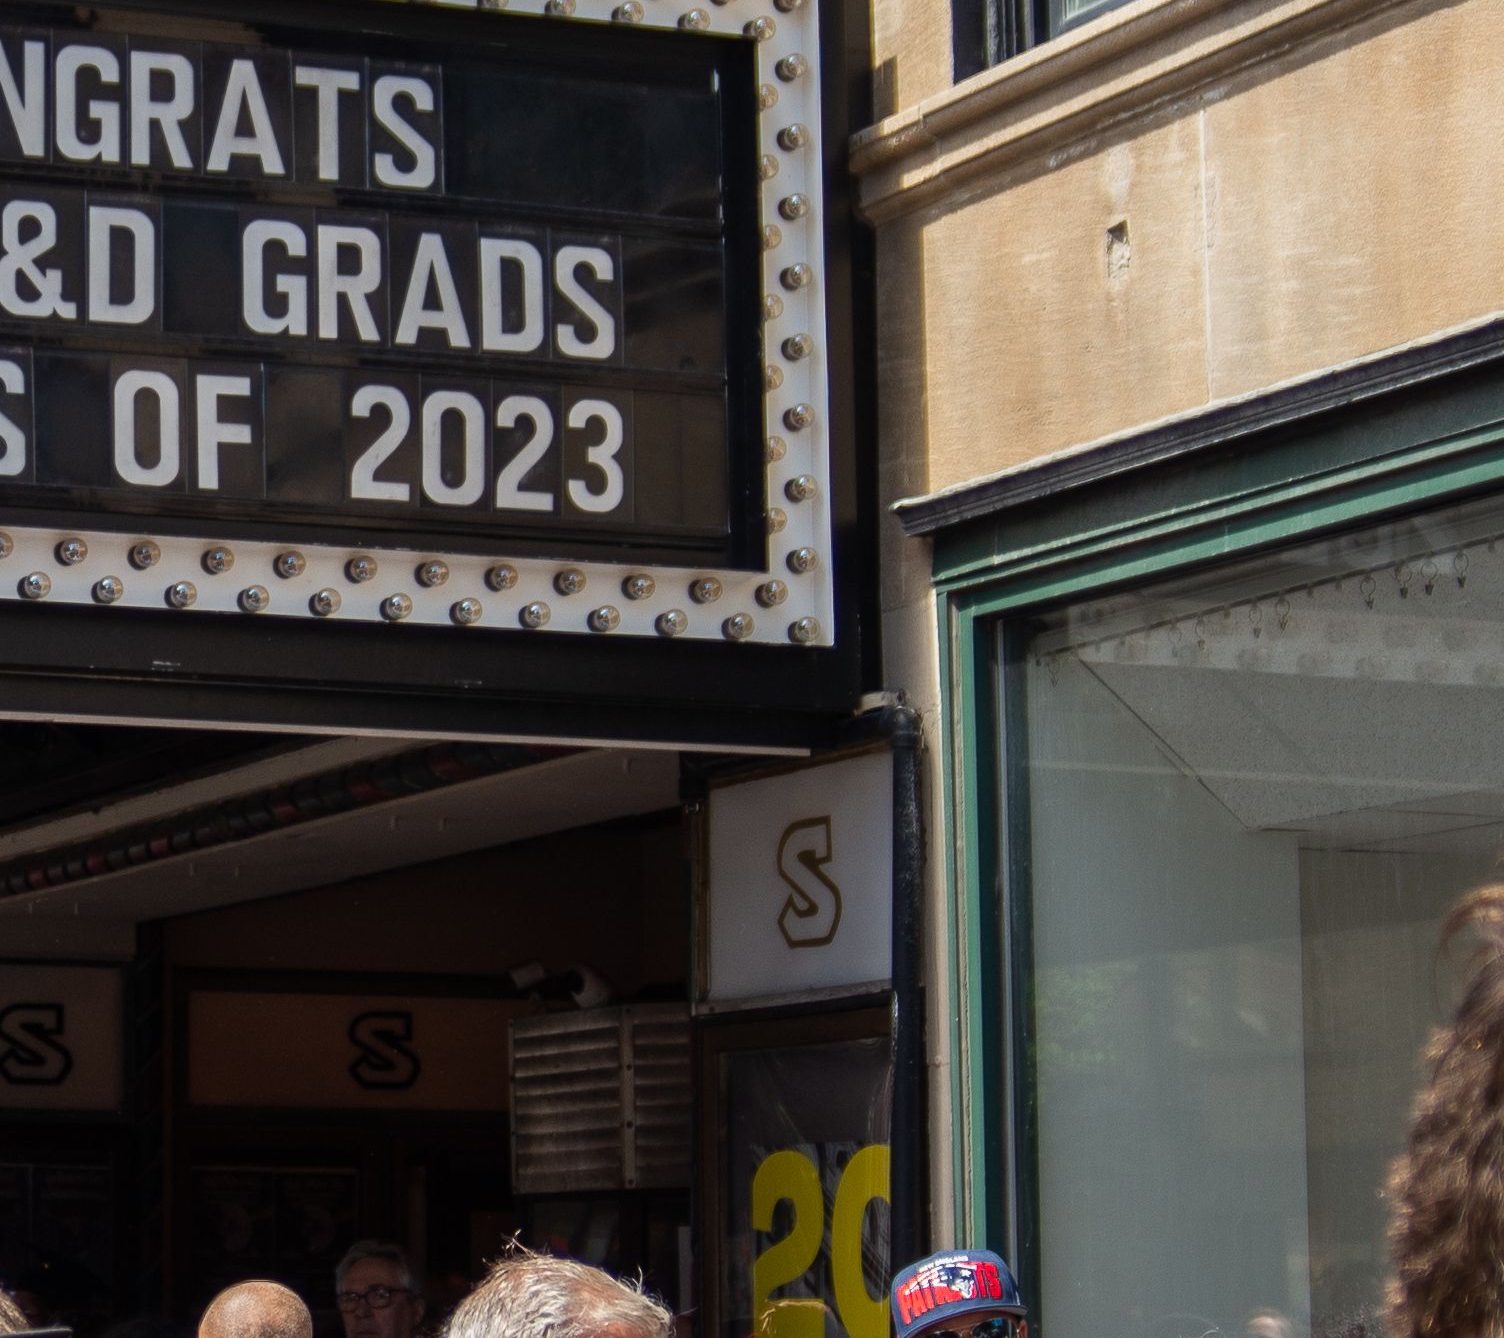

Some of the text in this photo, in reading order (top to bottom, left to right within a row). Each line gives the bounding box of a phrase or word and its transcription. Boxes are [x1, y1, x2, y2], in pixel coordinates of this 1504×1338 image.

[241, 218, 617, 361] GRADS
[112, 369, 253, 491] OF
[349, 384, 625, 513] 2023
[776, 815, 843, 949] S
[348, 1009, 422, 1091] S
[895, 1261, 1003, 1326] PATRITS
